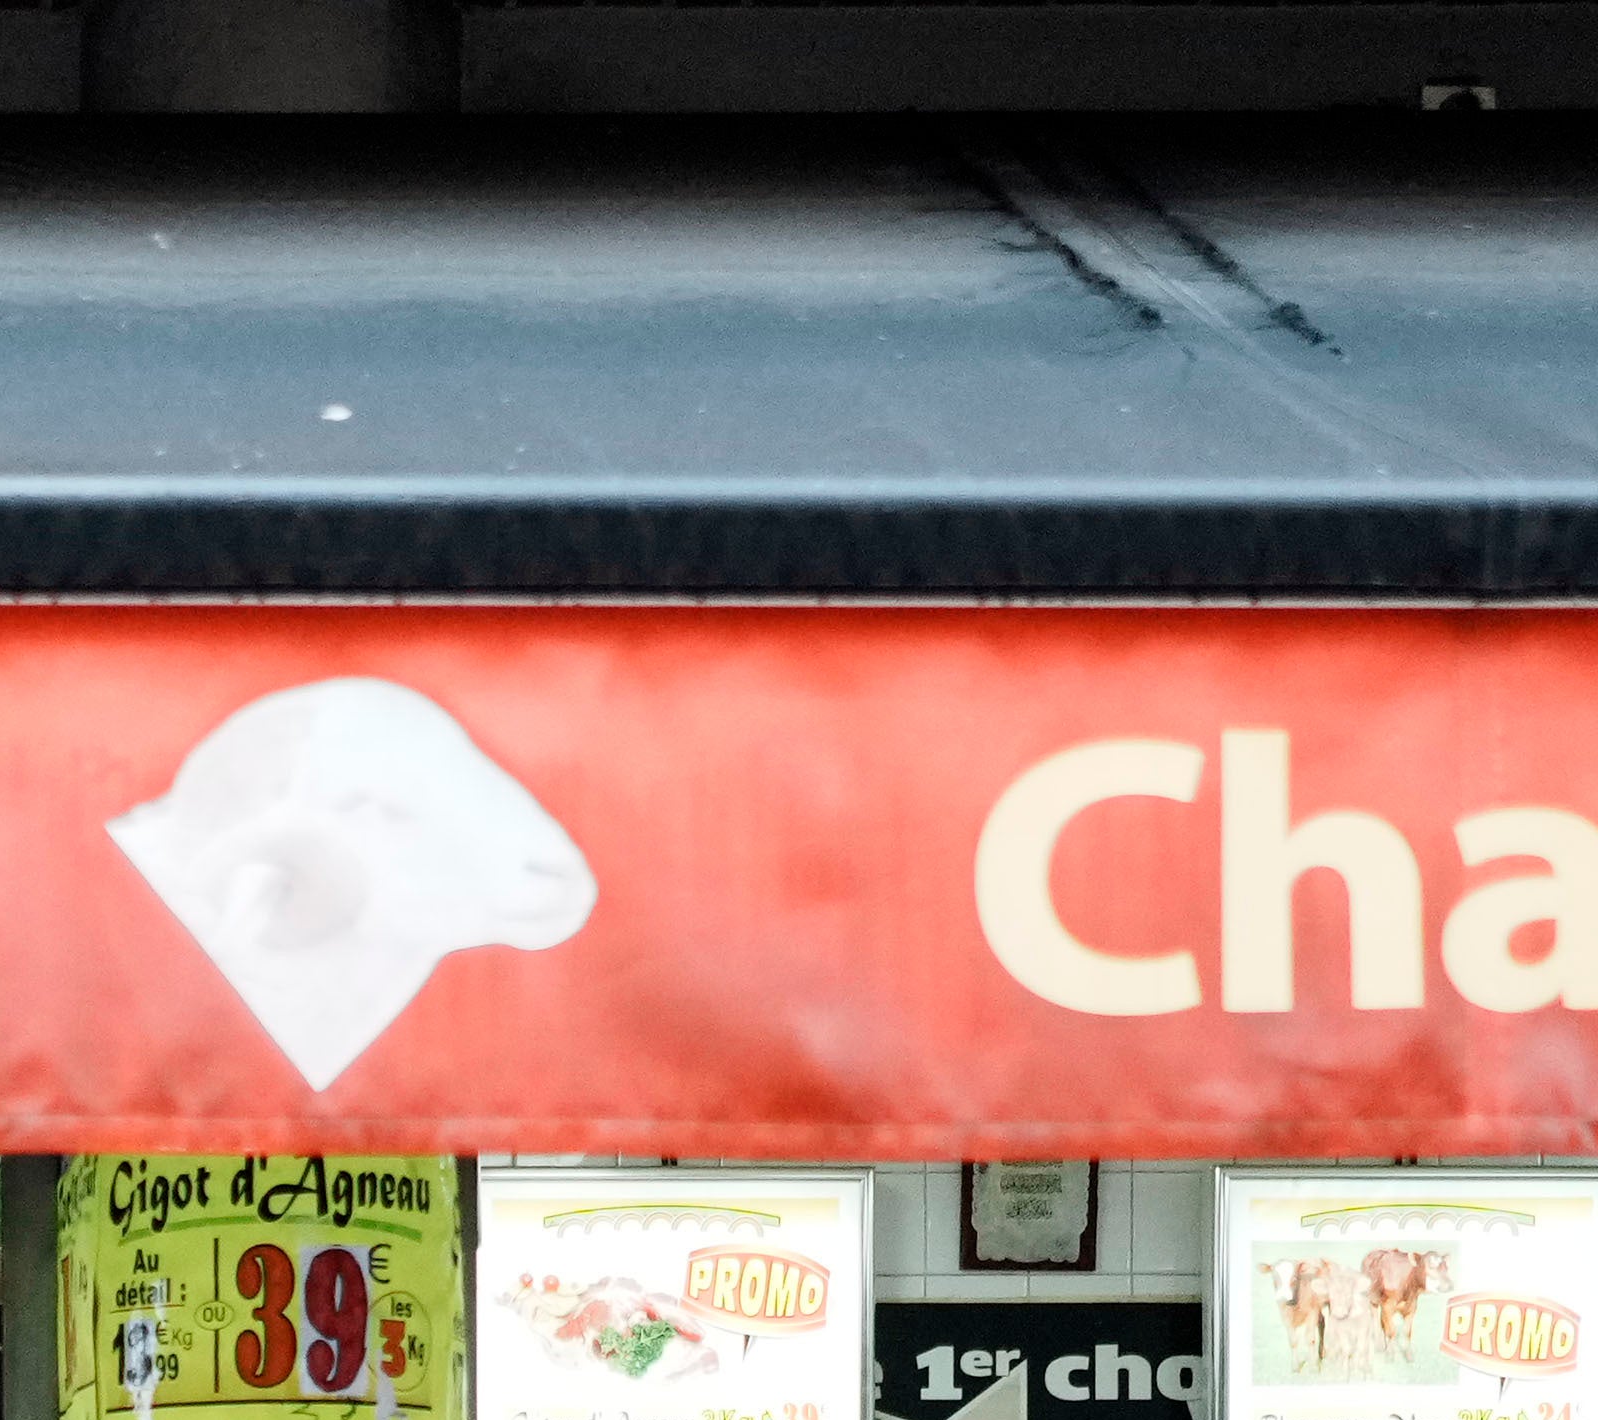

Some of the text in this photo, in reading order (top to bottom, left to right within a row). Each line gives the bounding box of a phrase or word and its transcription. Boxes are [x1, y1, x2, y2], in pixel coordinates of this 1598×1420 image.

[109, 1154, 431, 1234] Gigot d'Agneau
[133, 1249, 159, 1273] Au
[115, 1279, 171, 1306] détail
[689, 1258, 824, 1318] PROMO
[203, 1306, 226, 1323] OU
[391, 1299, 413, 1317] les
[1447, 1304, 1575, 1360] PROMO
[156, 1355, 179, 1380] 99
